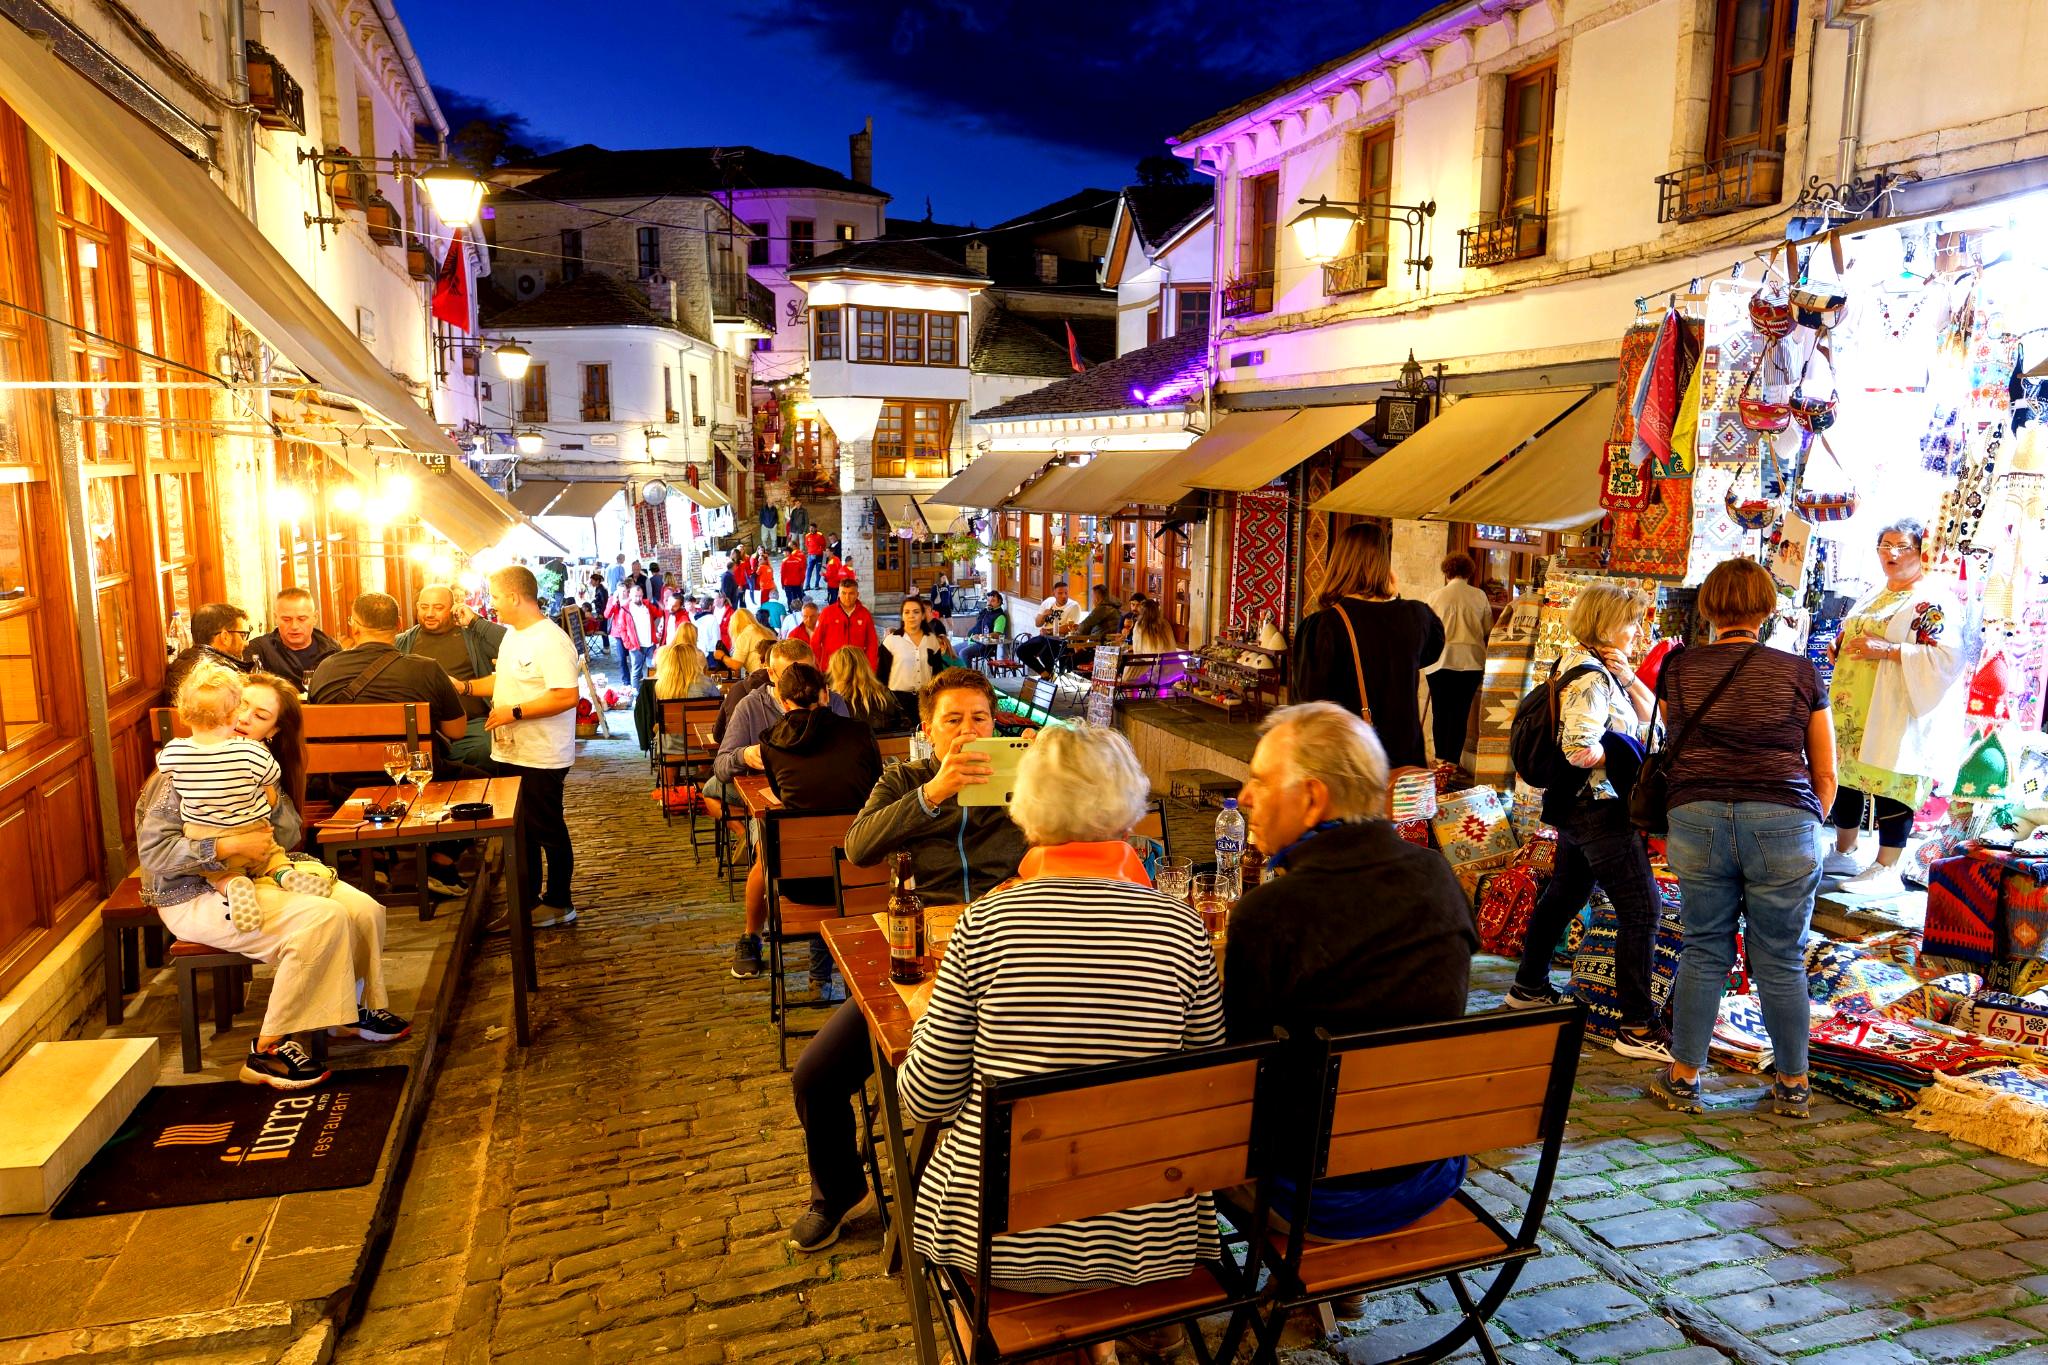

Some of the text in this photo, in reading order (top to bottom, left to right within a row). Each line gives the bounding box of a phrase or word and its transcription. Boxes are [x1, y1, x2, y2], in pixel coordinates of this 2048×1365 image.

[416, 453, 445, 465] rra
[1217, 841, 1237, 849] GLINA
[312, 1093, 351, 1157] restaurant
